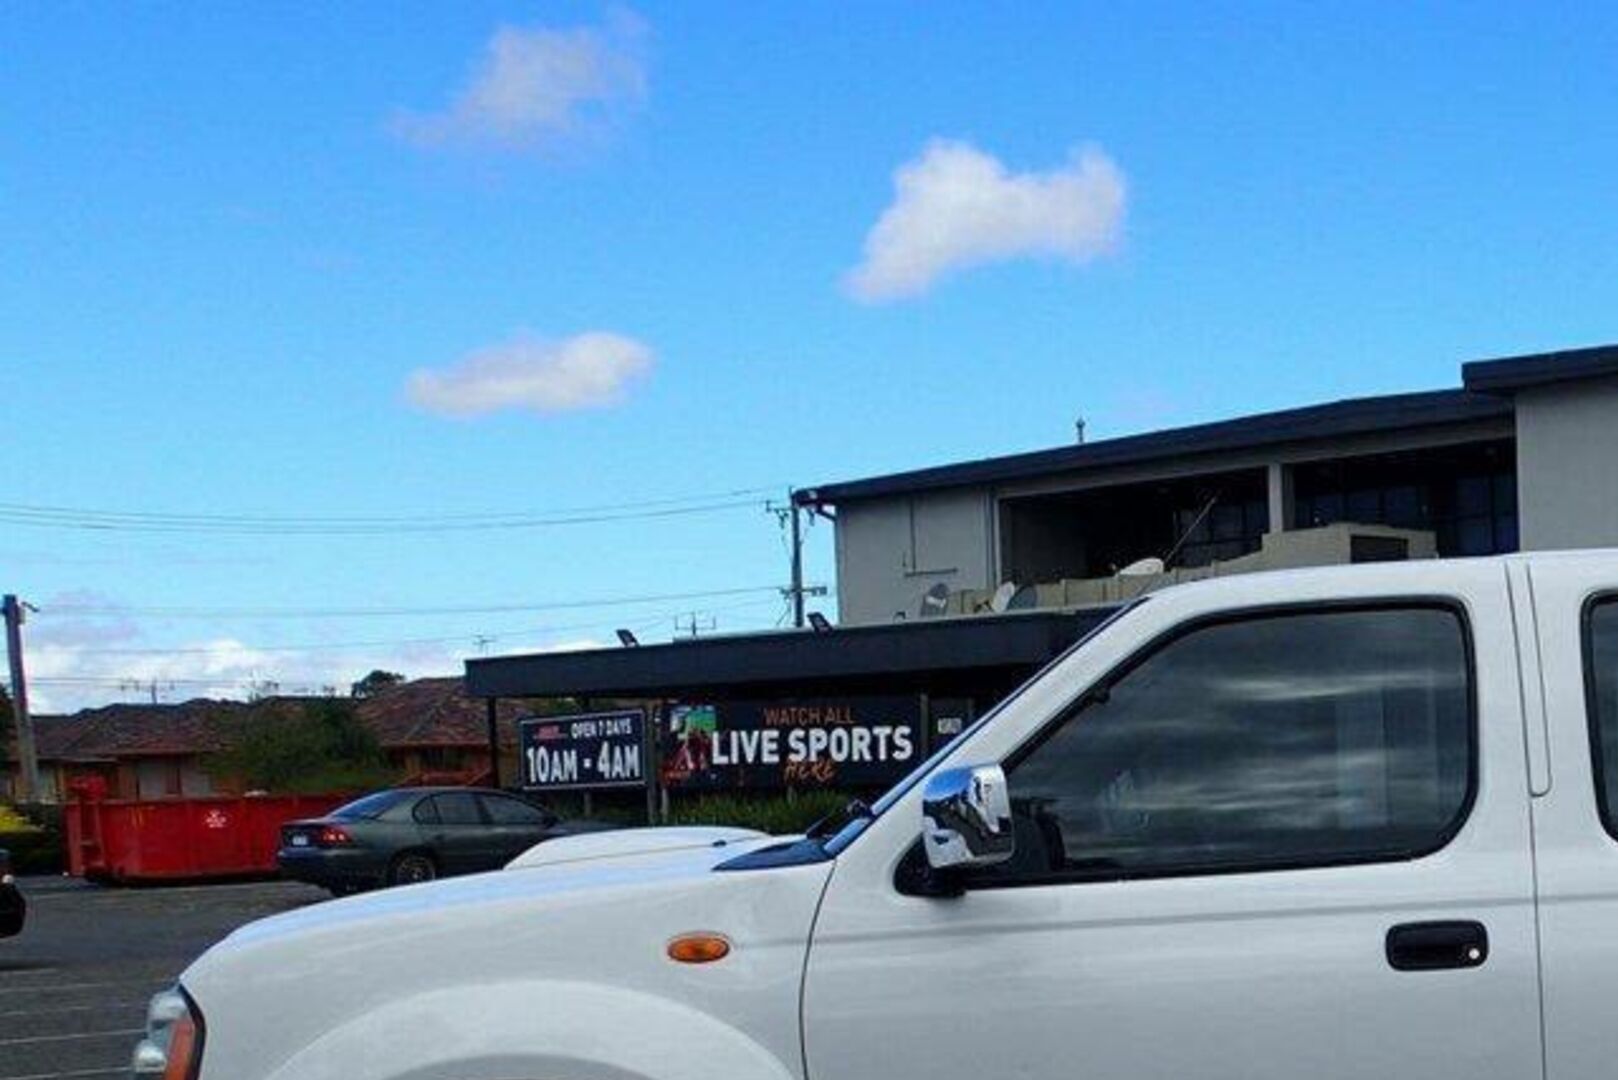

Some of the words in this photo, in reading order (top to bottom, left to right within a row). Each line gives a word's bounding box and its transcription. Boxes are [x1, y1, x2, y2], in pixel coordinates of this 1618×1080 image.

[571, 721, 597, 739] OPEN
[606, 717, 632, 736] DAYS
[764, 706, 823, 726] WATCH
[825, 706, 854, 725] ALL
[711, 729, 780, 765] LIVE
[787, 725, 913, 763] SPORTS
[526, 744, 578, 783] 10AM
[597, 741, 640, 779] 4AM
[784, 757, 836, 783] HERE
